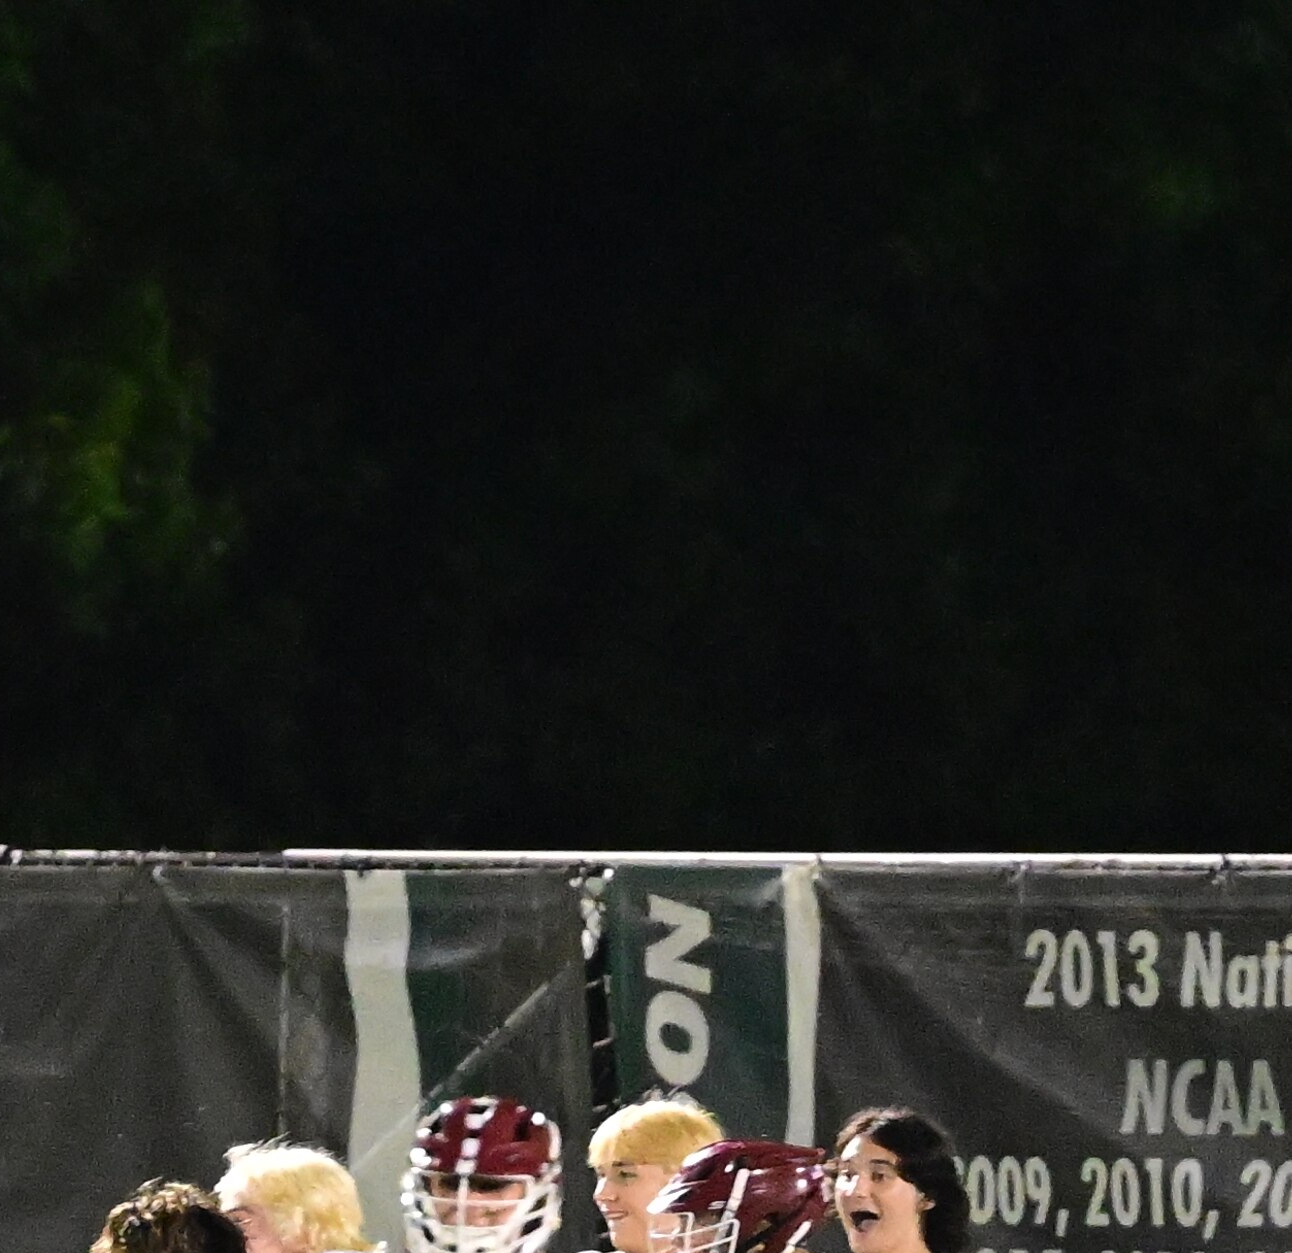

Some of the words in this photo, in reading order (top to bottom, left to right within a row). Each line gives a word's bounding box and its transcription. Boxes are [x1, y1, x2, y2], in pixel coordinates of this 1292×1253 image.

[1024, 929, 1160, 1008] 2013
[1119, 1058, 1285, 1136] NCAA
[953, 1155, 1066, 1237] 009,
[1080, 1157, 1219, 1239] 2010,
